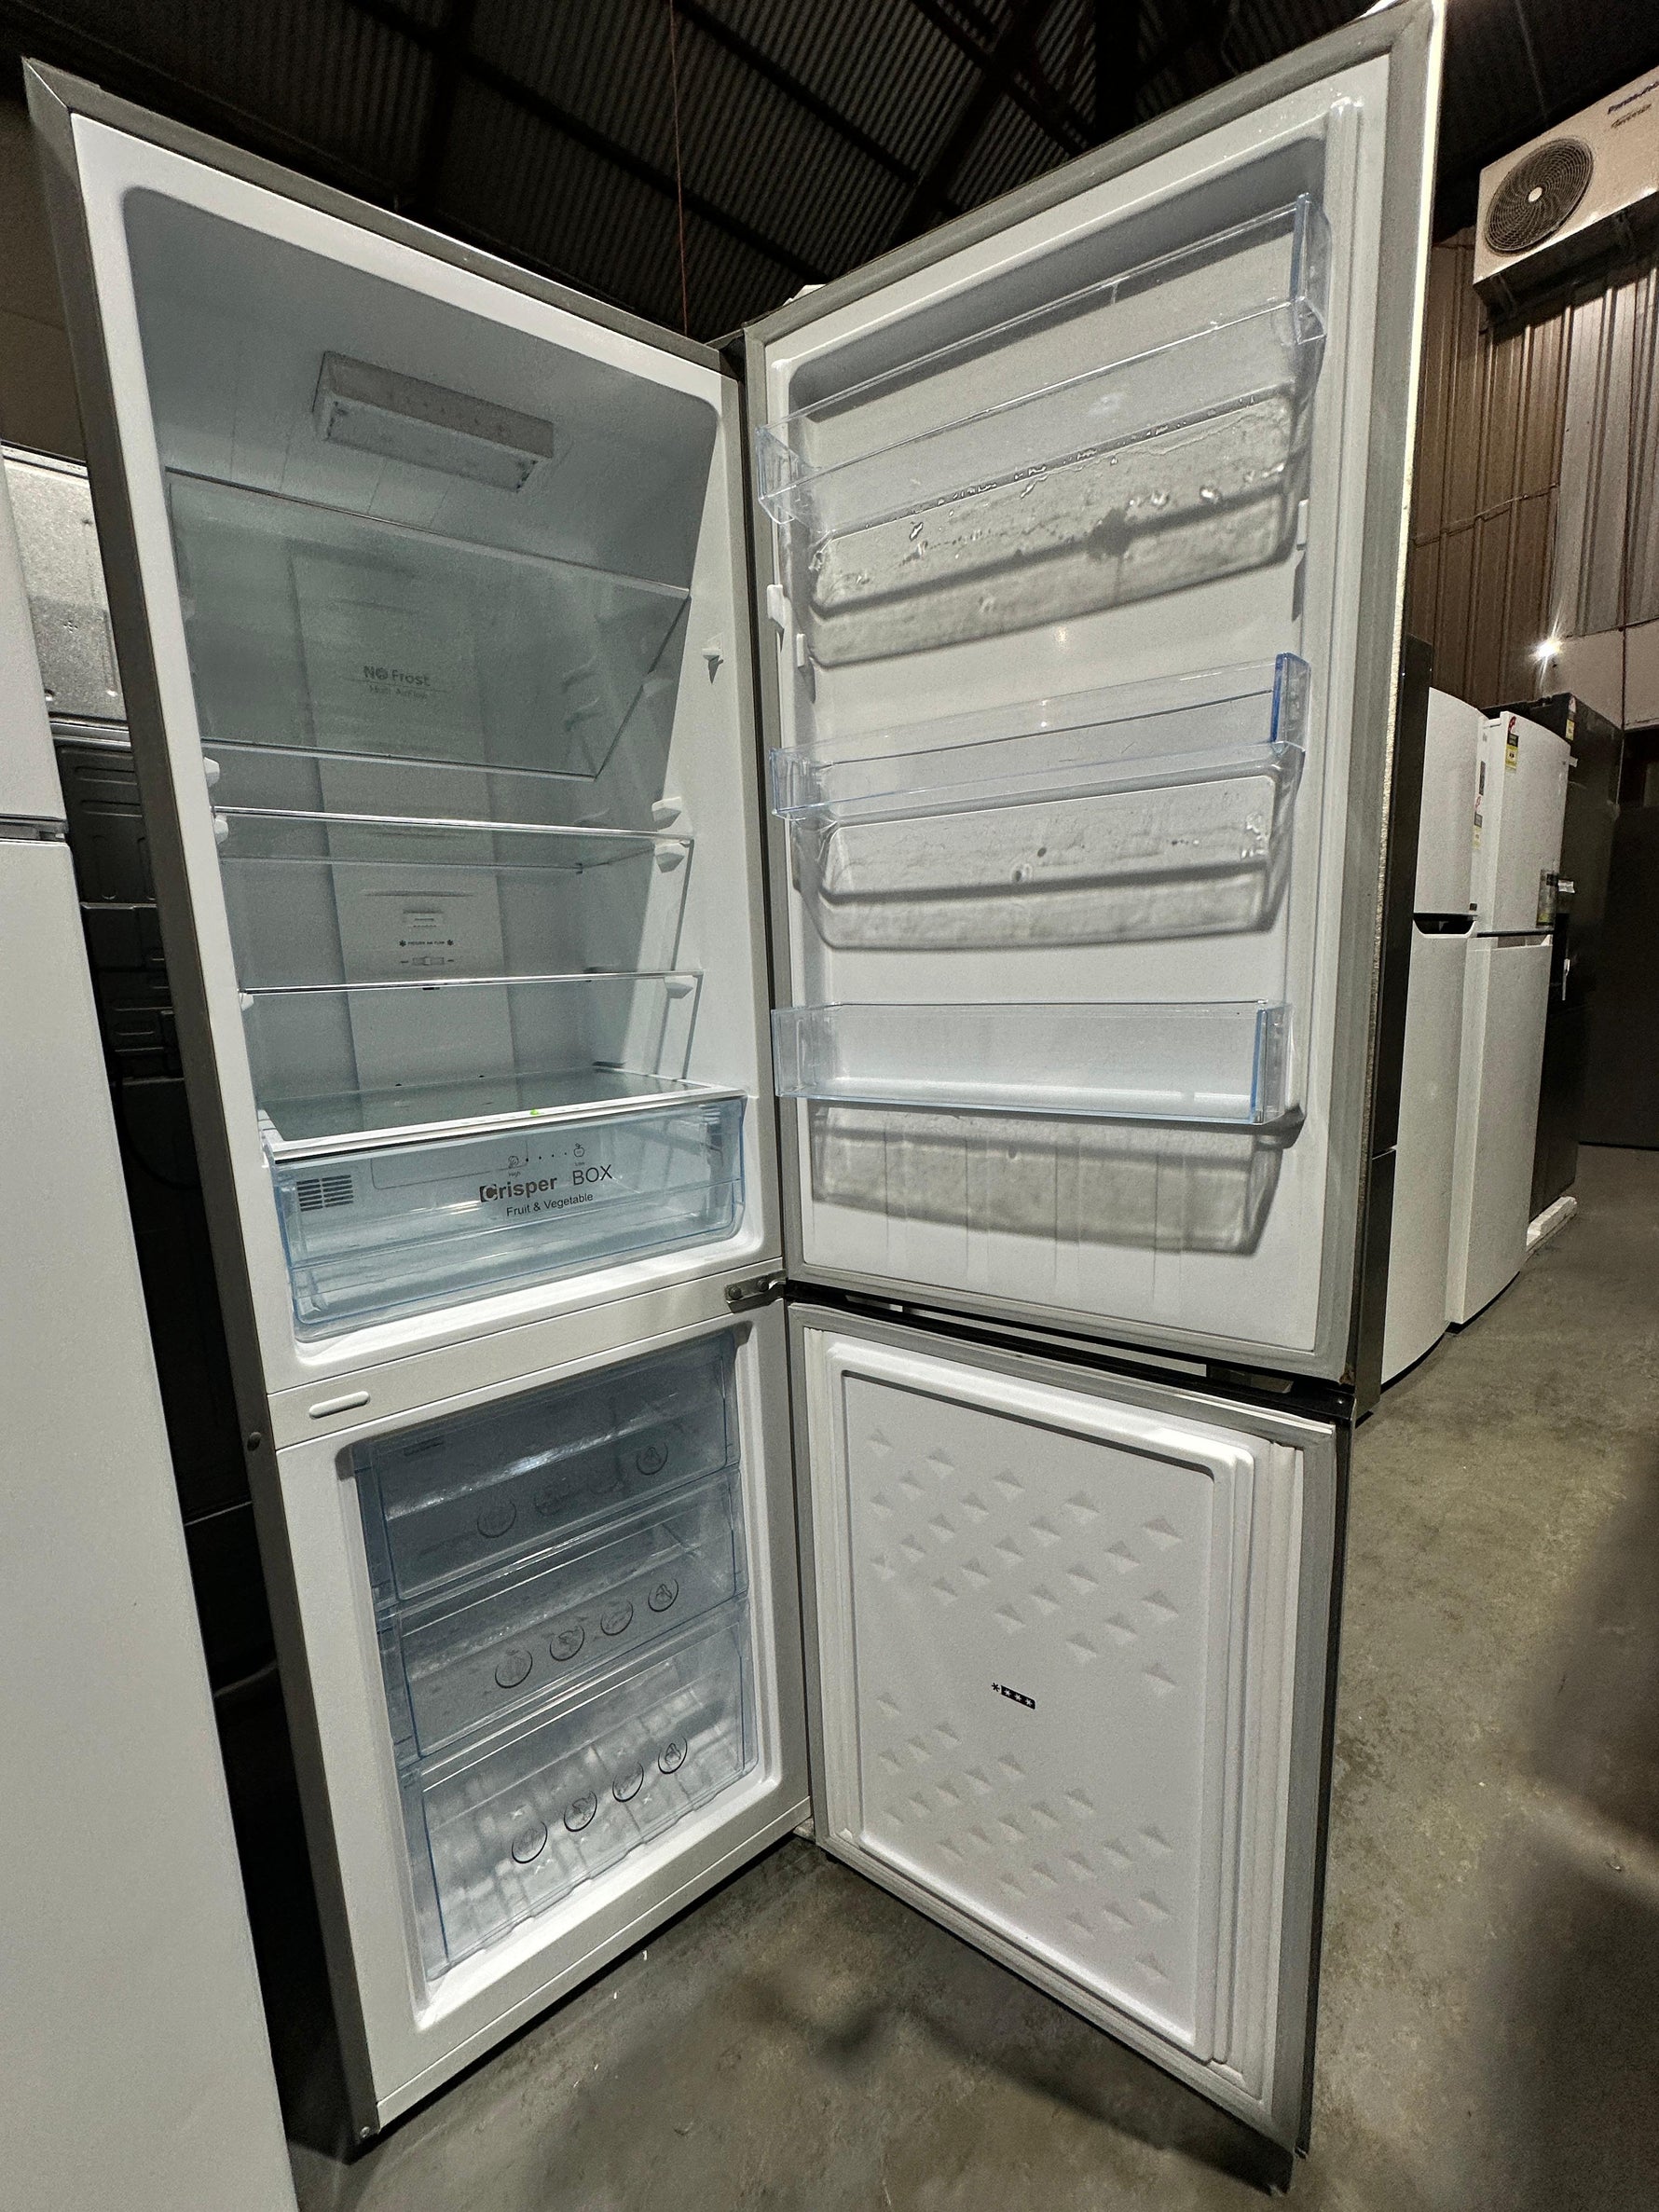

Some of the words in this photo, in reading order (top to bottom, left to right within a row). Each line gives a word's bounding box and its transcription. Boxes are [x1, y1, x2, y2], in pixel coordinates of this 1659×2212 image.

[391, 669, 431, 687] Frost
[479, 1177, 557, 1202] Crisper
[572, 1164, 613, 1186] BOX
[506, 1203, 530, 1216] Fruit
[533, 1202, 542, 1212] &
[543, 1192, 594, 1210] Vegetable
